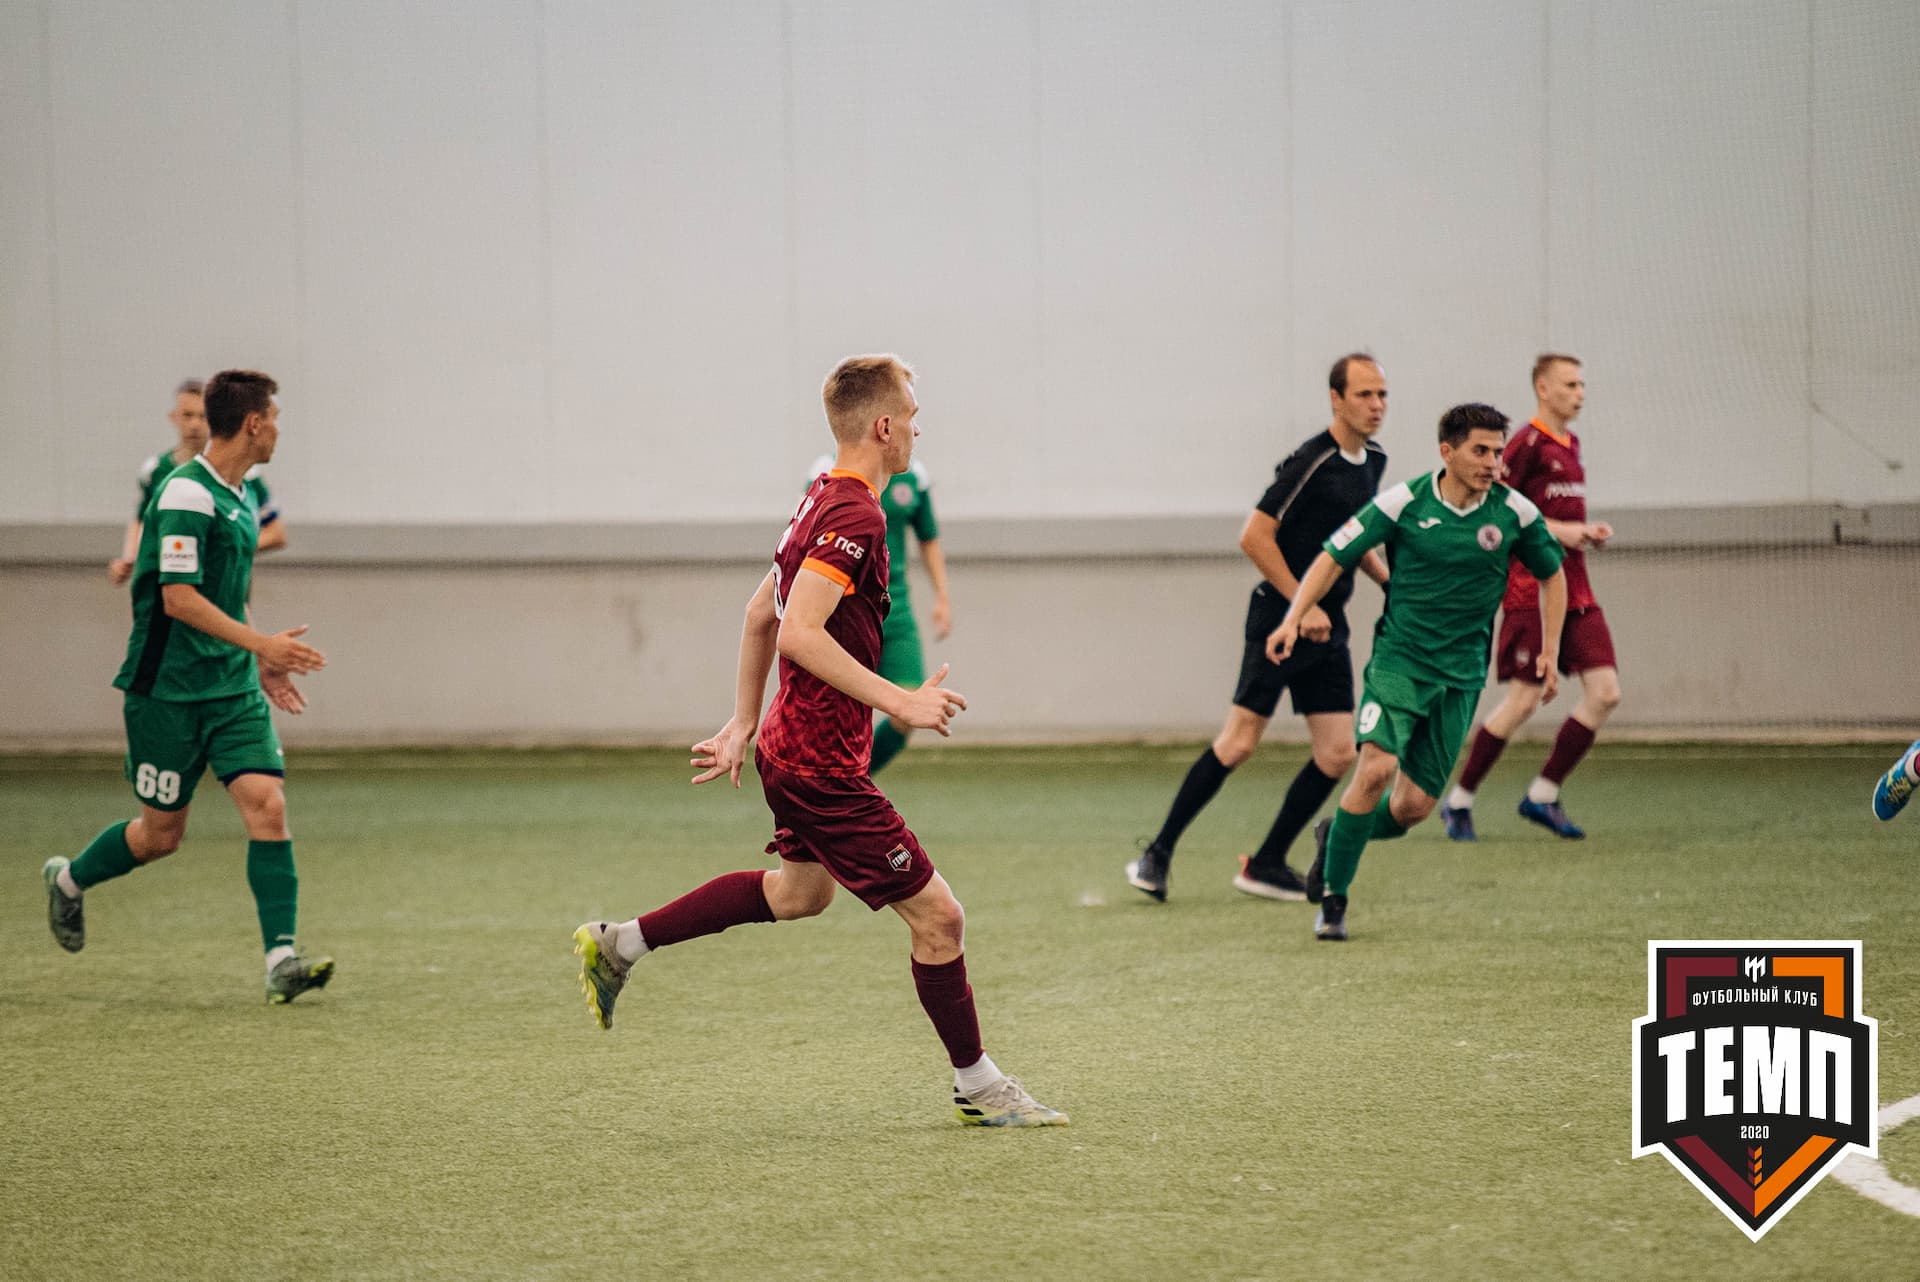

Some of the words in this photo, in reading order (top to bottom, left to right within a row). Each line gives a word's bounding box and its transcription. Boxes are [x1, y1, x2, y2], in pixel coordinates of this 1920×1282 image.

[834, 536, 865, 560] ПСБ
[1359, 701, 1382, 734] 9
[136, 763, 181, 805] 69
